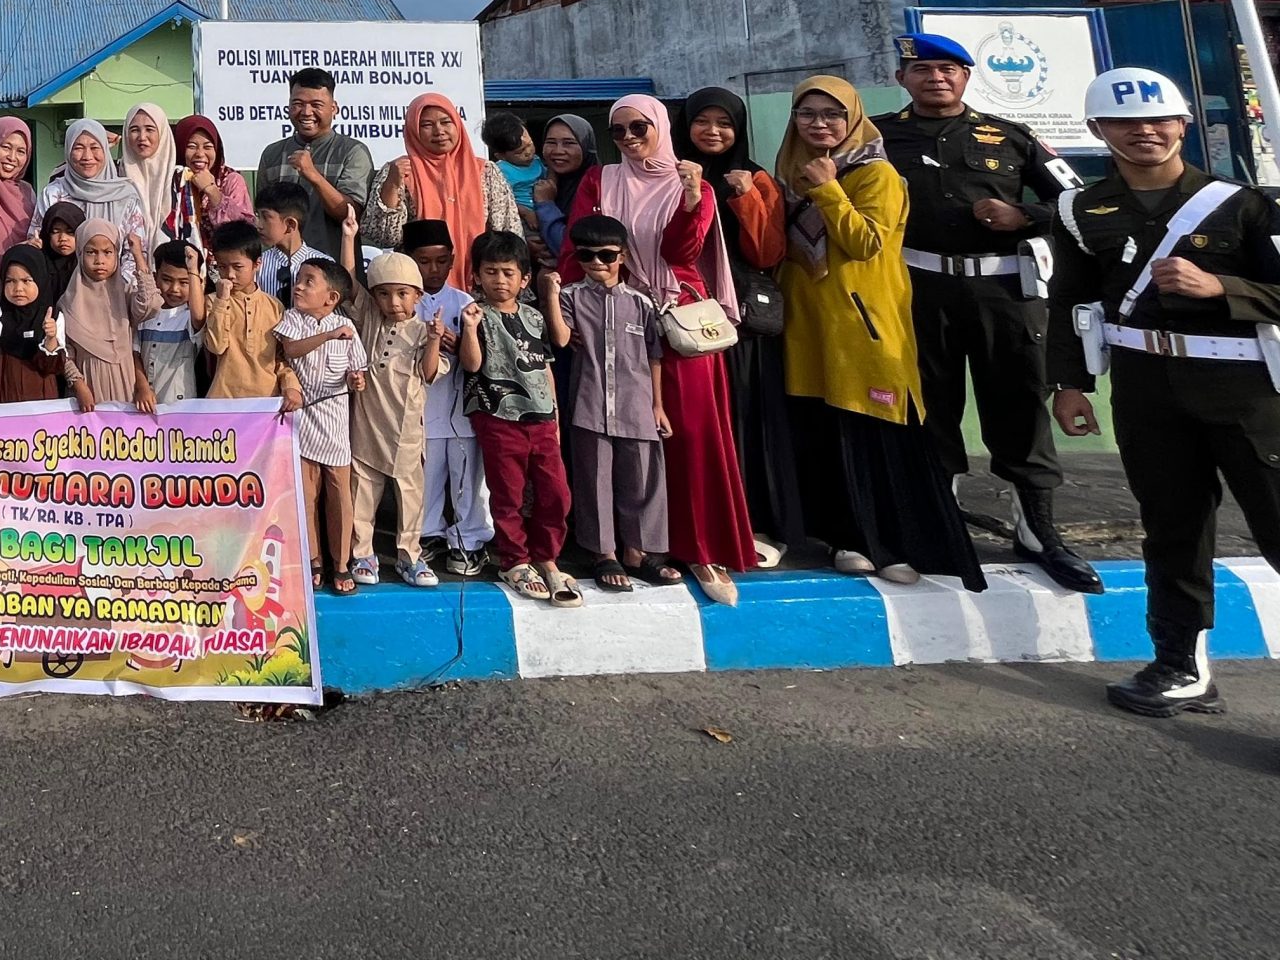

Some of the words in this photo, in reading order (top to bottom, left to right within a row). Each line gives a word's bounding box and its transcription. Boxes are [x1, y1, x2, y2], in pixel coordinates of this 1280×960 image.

[218, 49, 261, 66] POLISI
[265, 50, 319, 67] MILITER
[323, 50, 377, 67] DAERAH
[381, 50, 436, 67] MILITER
[249, 70, 295, 84] TUAN
[328, 70, 364, 85] MAM
[369, 71, 434, 85] BONJOL
[1111, 80, 1165, 105] PM
[218, 105, 245, 121] SUB
[249, 105, 290, 121] DETAS
[379, 105, 409, 121] MILI
[32, 426, 96, 471] Syekh
[100, 427, 164, 462] Abdul
[167, 426, 237, 463] Hamid
[141, 472, 266, 509] BUNDA
[83, 534, 203, 567] TAKJIL
[20, 571, 76, 587] Kepedulian
[114, 577, 135, 589] Dan
[137, 578, 180, 593] Berbagi
[181, 578, 220, 593] Kepada
[222, 576, 257, 591] Seama
[58, 595, 92, 618] YA
[95, 596, 227, 627] RAMADHAN
